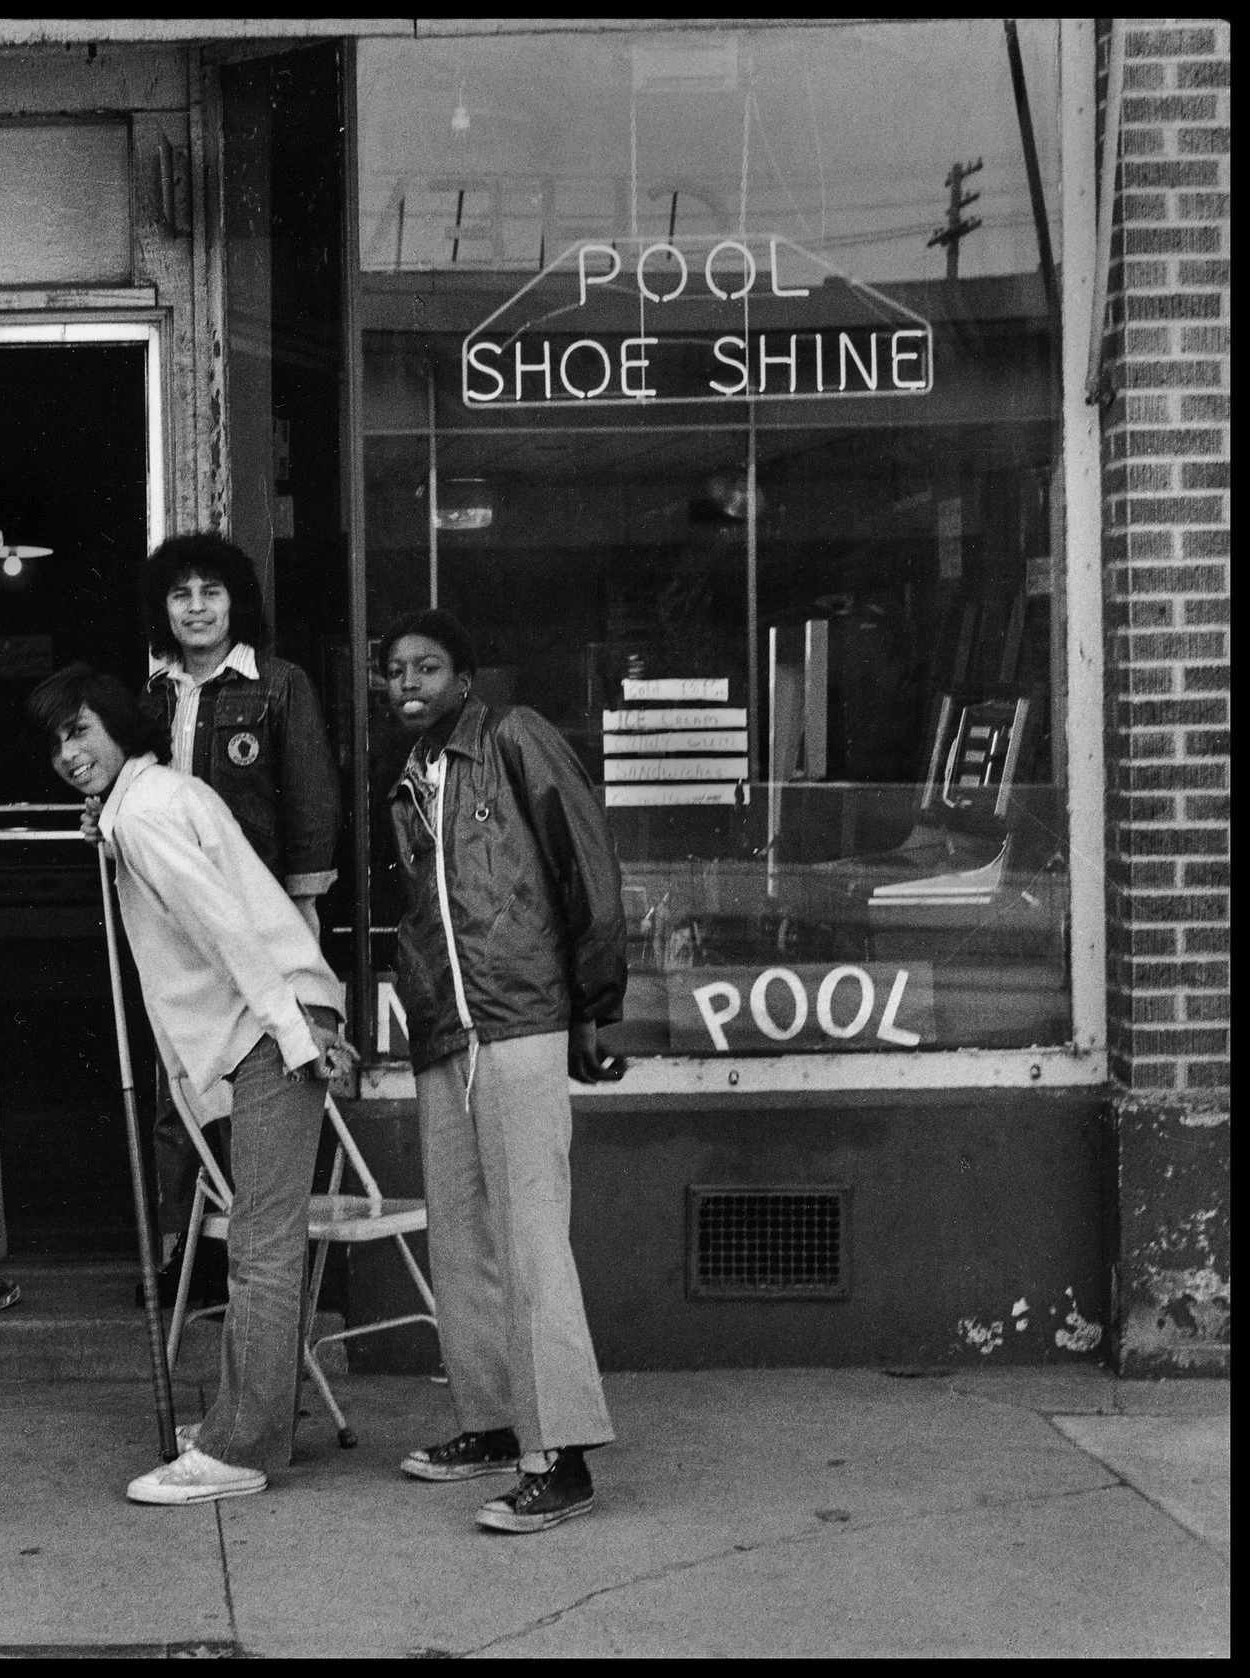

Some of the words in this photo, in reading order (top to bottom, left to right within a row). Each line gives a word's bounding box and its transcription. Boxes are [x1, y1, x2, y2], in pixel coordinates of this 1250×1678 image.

[578, 239, 810, 306] POOL
[466, 337, 658, 401] SHOE
[709, 329, 927, 395] SHINE
[618, 709, 648, 730] ICE
[692, 965, 921, 1051] POOL
